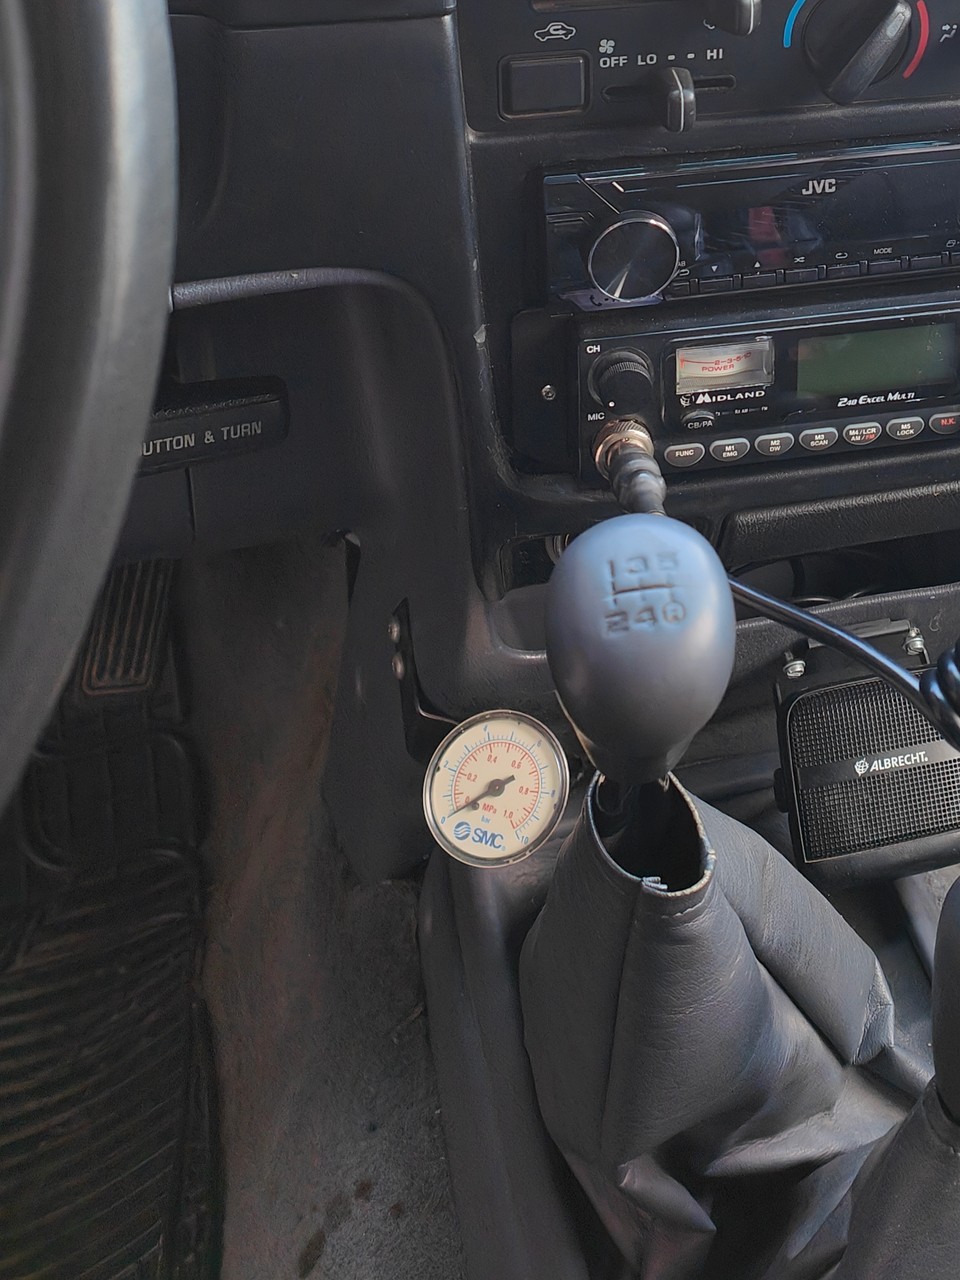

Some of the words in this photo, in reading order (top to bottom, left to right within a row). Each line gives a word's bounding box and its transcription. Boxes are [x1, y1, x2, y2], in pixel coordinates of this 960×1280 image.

[599, 56, 628, 68] OFF
[637, 54, 657, 66] LO
[706, 48, 723, 60] HI
[801, 178, 836, 195] JVC
[873, 247, 893, 255] MODE
[586, 345, 601, 354] CH
[701, 363, 735, 372] POWER
[587, 412, 605, 421] MIC
[687, 420, 713, 429] CB/PA
[940, 418, 956, 427] N.K.
[141, 433, 195, 456] UTTON
[204, 430, 215, 444] &
[221, 420, 262, 440] TURN
[675, 449, 695, 457] FUNC
[444, 760, 449, 768] 2
[482, 803, 497, 814] MPa
[441, 816, 446, 824] 0
[480, 815, 491, 824] bar
[471, 827, 504, 849] SMC
[520, 836, 529, 845] 10
